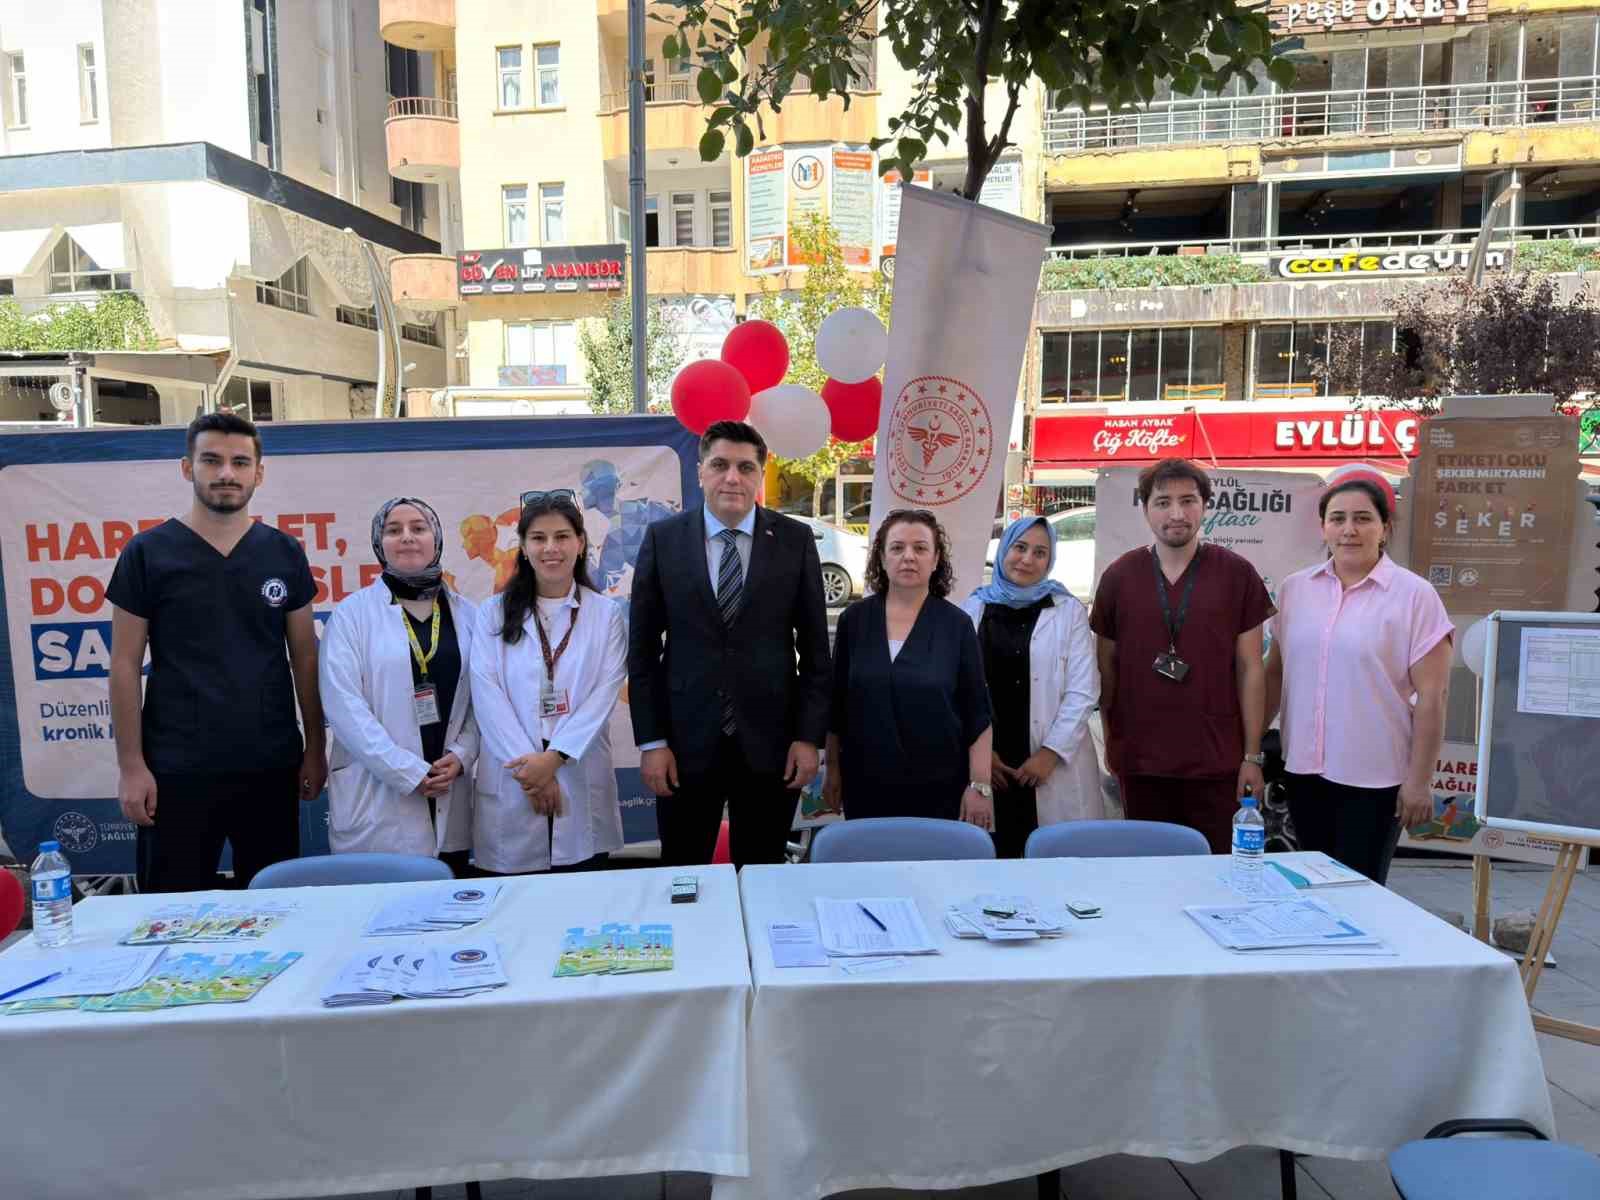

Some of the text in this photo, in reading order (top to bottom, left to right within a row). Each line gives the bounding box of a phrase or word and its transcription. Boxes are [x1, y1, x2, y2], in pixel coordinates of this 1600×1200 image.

[1367, 0, 1469, 20] OKEY
[1104, 419, 1138, 428] HASAN
[1093, 428, 1179, 455] Çiğ Köfte
[1276, 414, 1385, 446] EYLÜL
[1395, 419, 1416, 452] Ç
[1507, 454, 1547, 467] OKU
[1436, 481, 1507, 494] FARK ET
[37, 628, 112, 672] SA
[40, 700, 110, 718] Düzenli
[43, 724, 104, 741] kronik
[101, 832, 137, 841] SAĞLIK
